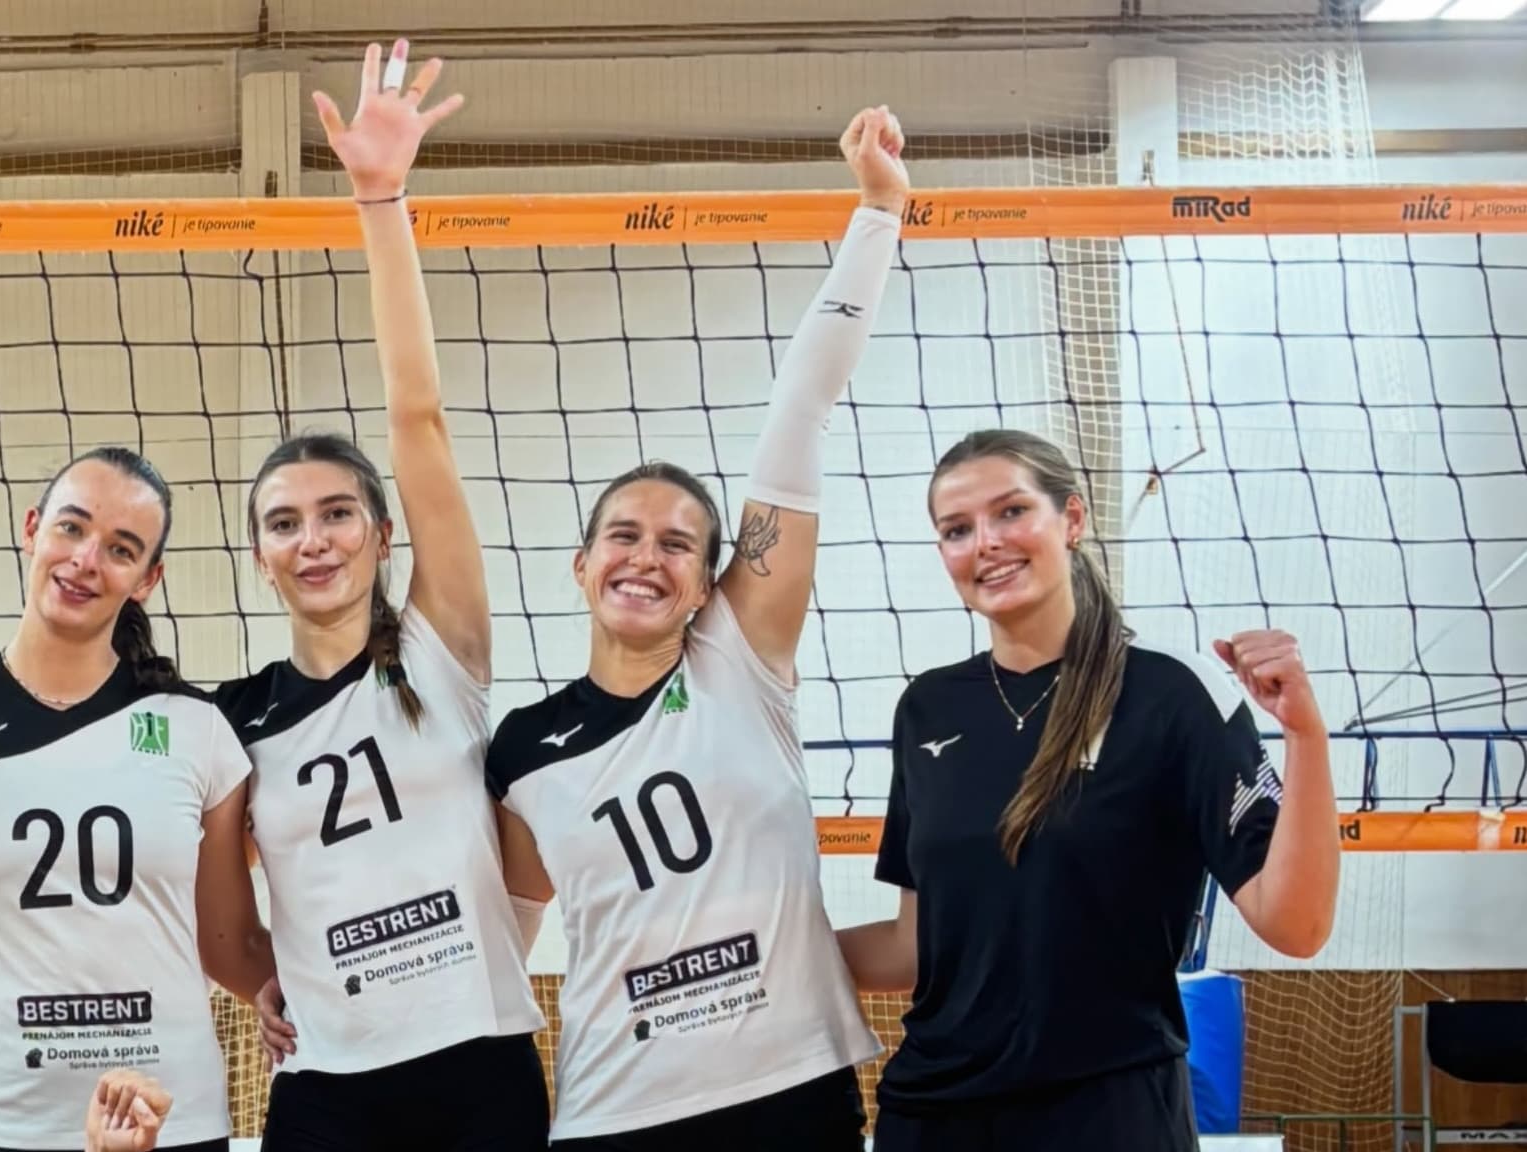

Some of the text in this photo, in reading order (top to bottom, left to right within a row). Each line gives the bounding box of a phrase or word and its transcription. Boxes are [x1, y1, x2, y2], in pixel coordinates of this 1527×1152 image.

[625, 203, 675, 230] niké
[1402, 193, 1452, 220] niké
[115, 210, 165, 238] niké
[296, 735, 403, 847] 21
[591, 771, 713, 891] 10
[12, 804, 133, 910] 20
[333, 896, 450, 951] BESTRENT
[364, 955, 424, 982] Domová
[631, 939, 751, 997] BESTRENT
[22, 996, 146, 1022] BESTRENT
[47, 1046, 110, 1061] Domová
